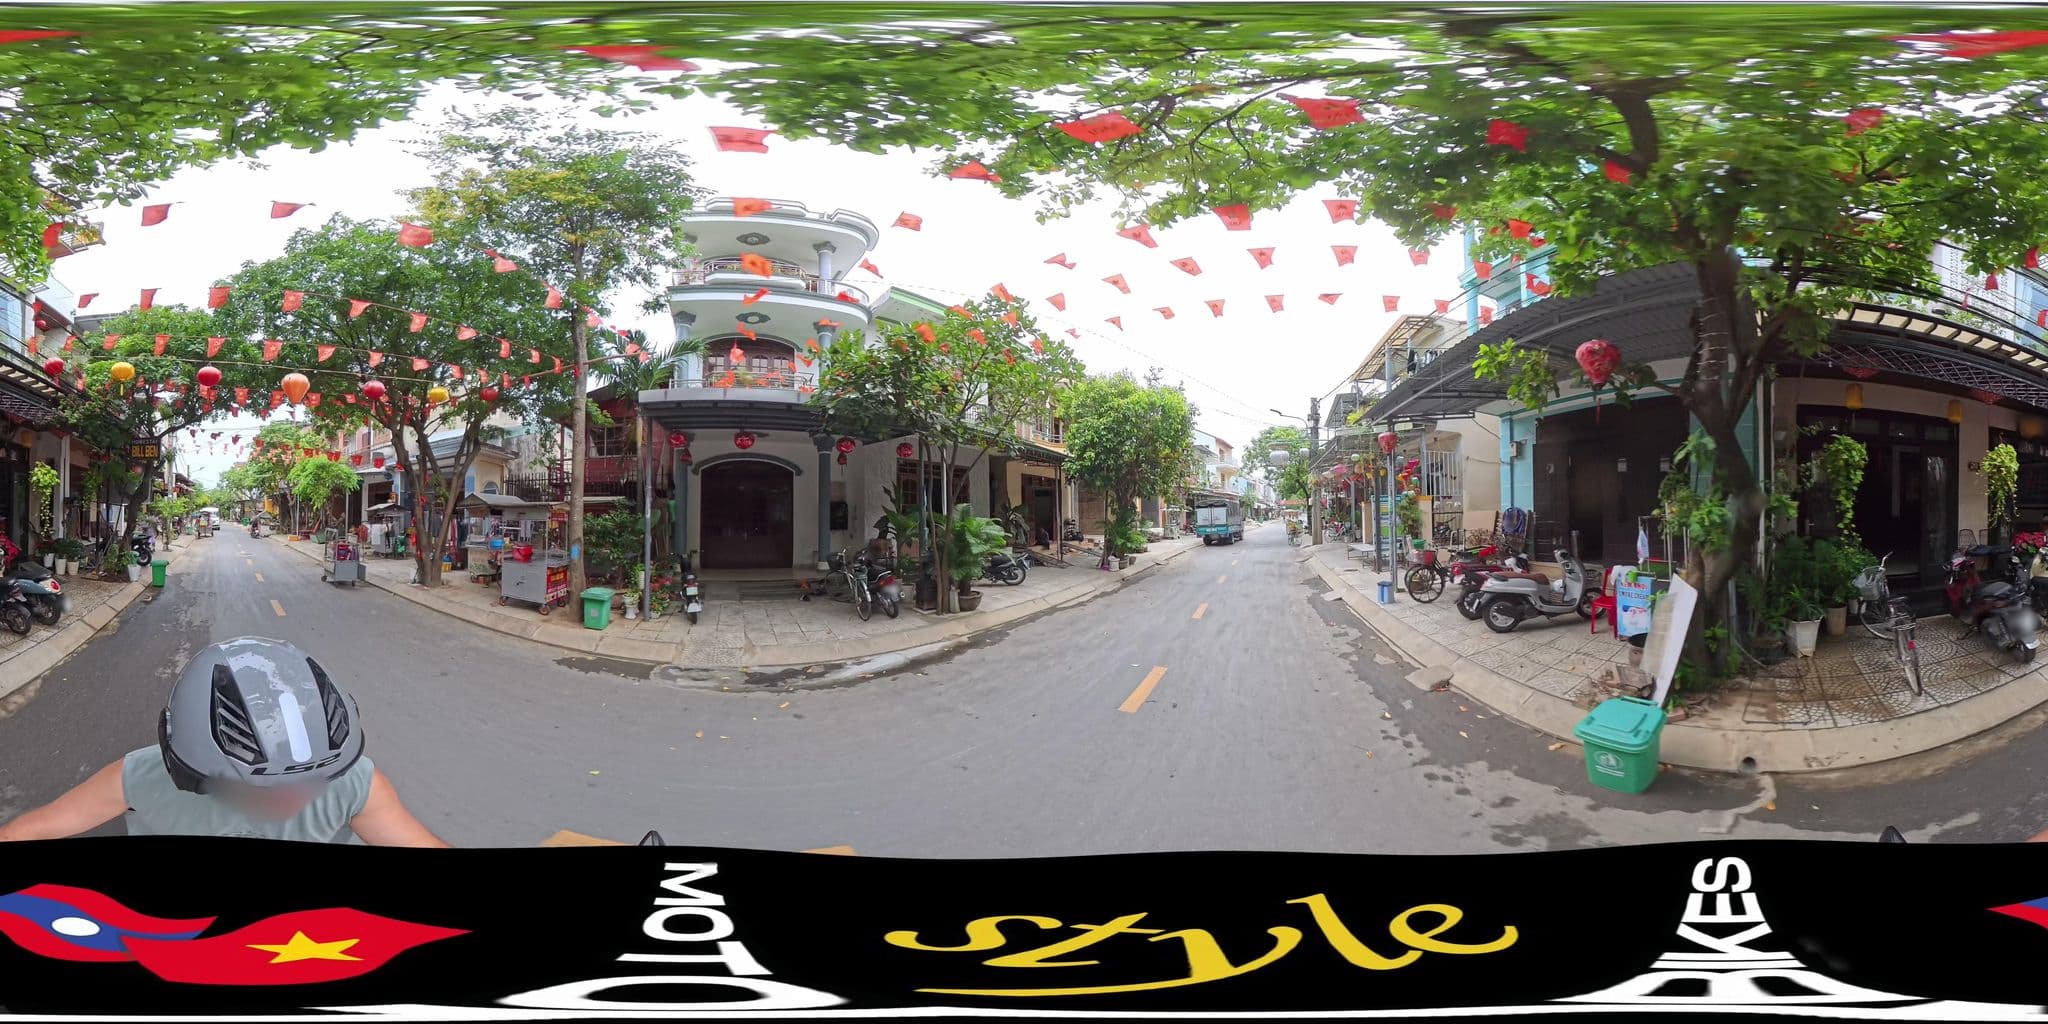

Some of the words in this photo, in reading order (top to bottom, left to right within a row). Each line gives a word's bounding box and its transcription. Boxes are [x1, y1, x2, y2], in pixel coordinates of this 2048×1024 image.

[132, 445, 144, 457] BILL
[145, 445, 158, 457] BEN
[250, 752, 341, 776] LS2
